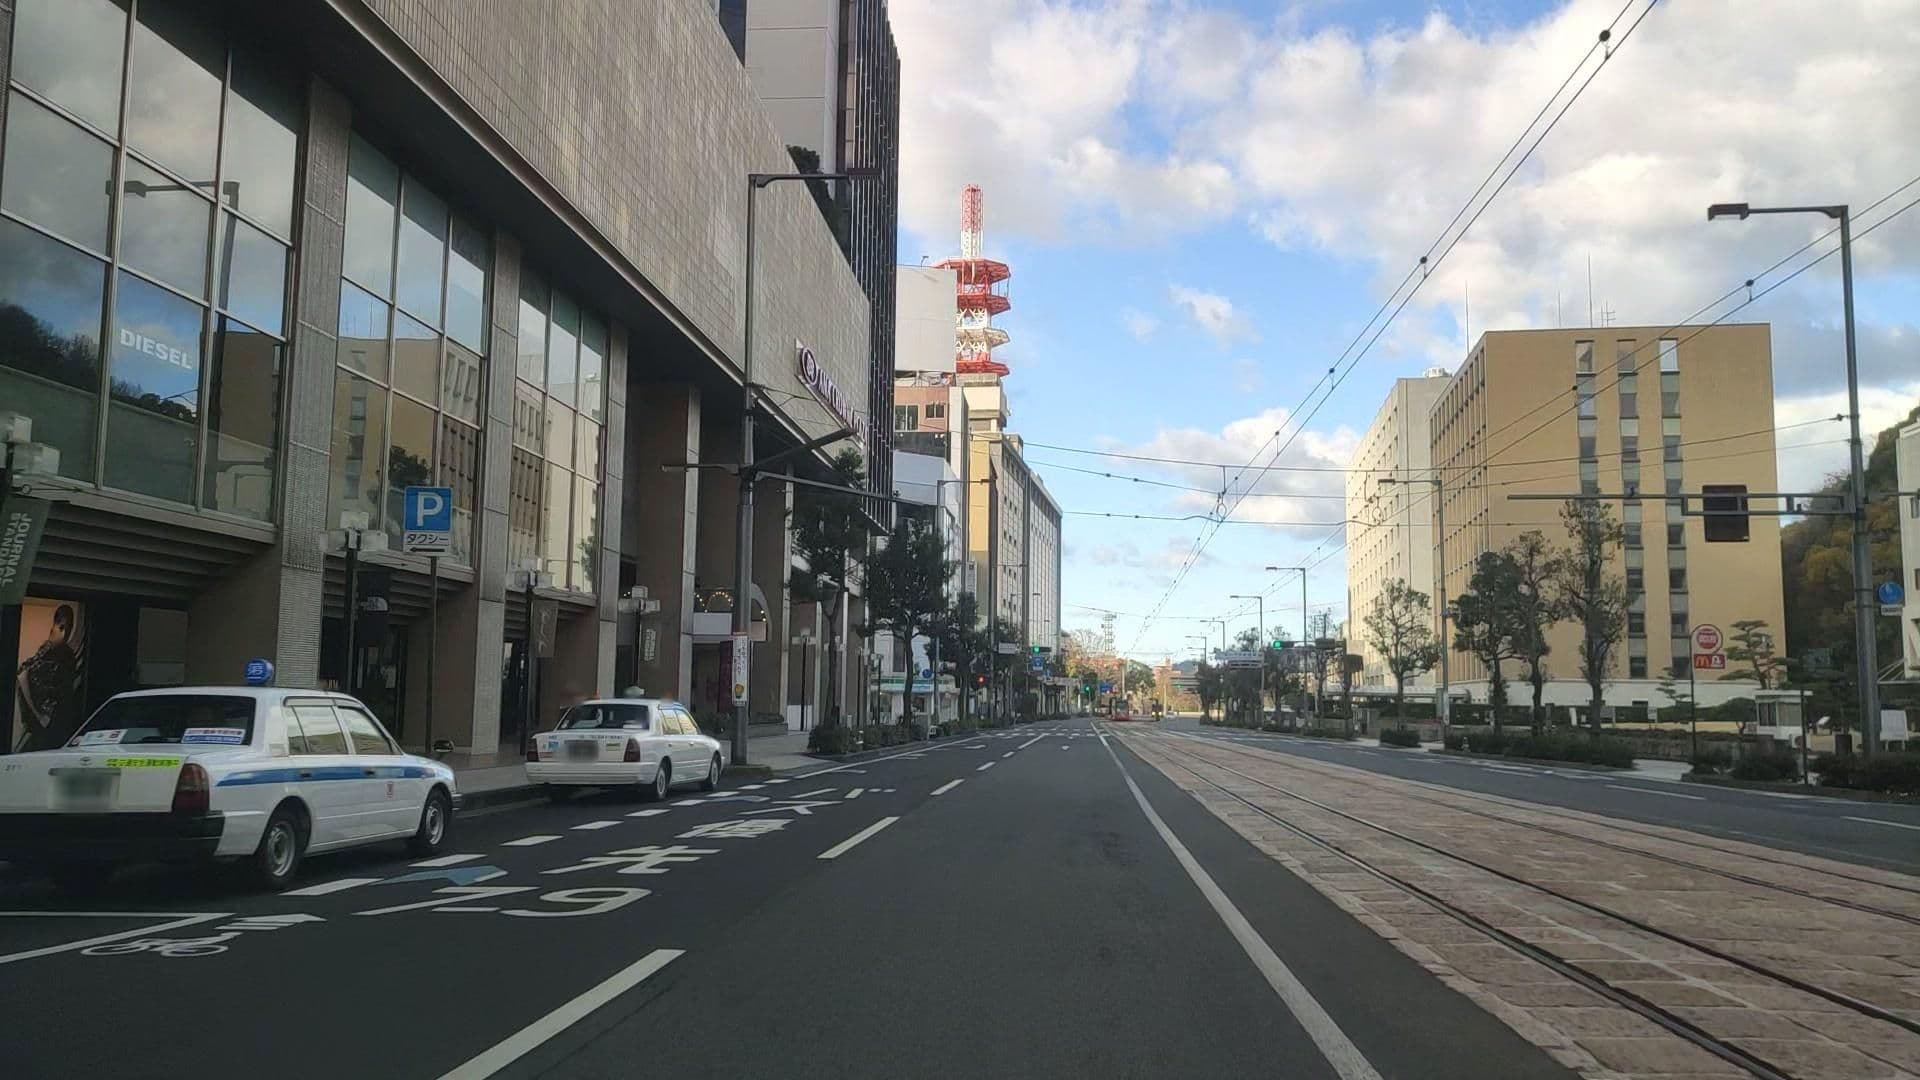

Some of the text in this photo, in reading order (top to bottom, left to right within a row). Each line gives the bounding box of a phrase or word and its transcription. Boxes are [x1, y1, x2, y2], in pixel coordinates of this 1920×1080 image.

[120, 329, 192, 369] DIESEL
[417, 492, 443, 527] P
[2, 513, 32, 586] JOURNAL
[407, 534, 449, 544] タクシー
[349, 887, 652, 917] 7-9
